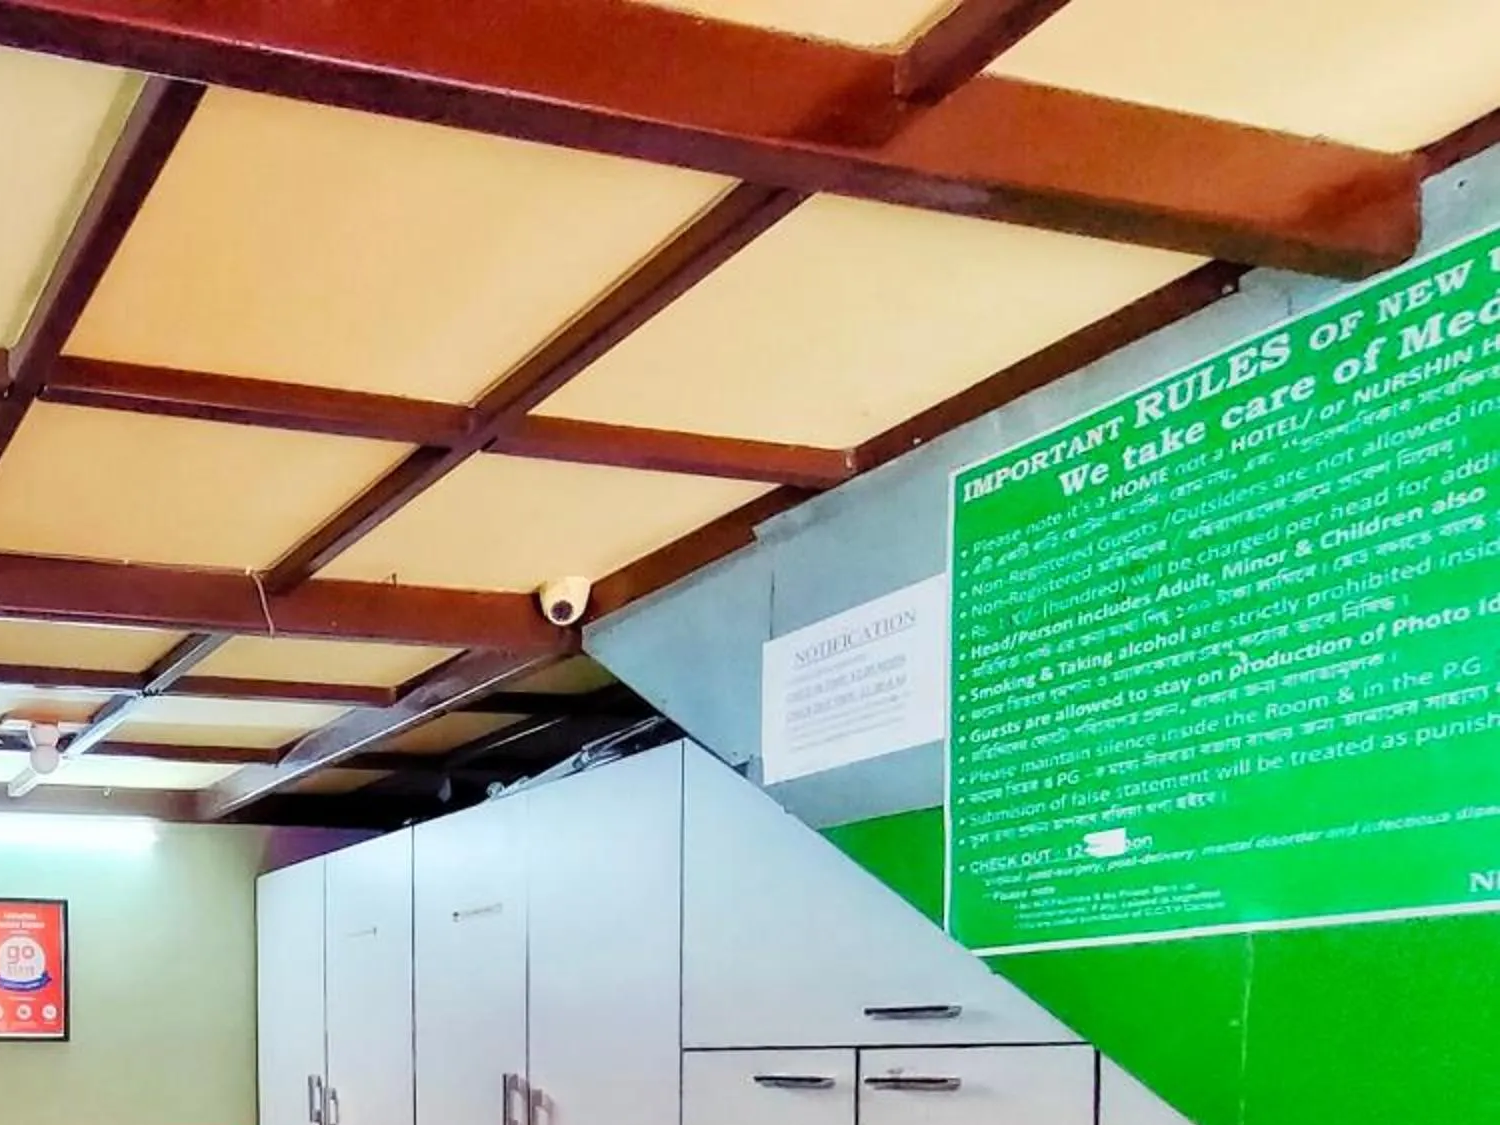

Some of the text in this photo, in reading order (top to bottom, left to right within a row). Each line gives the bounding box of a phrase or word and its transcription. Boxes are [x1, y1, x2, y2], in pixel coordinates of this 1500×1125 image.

[964, 413, 1123, 503] IMPORTANT
[1134, 330, 1290, 429] RULES
[1308, 307, 1363, 354] OF
[1377, 257, 1474, 325] NEW
[1058, 451, 1108, 500] We
[1122, 410, 1206, 473] take
[1220, 372, 1316, 433] care
[1332, 333, 1387, 388] of
[1110, 464, 1169, 503] HOME
[1320, 397, 1345, 421] or
[1352, 343, 1472, 409] NURSHIN
[1096, 517, 1156, 553] Guests
[1273, 464, 1308, 489] are
[1316, 444, 1354, 474] not
[1362, 403, 1462, 458] allowed
[1196, 523, 1278, 569] charged
[1285, 510, 1323, 539] per
[1330, 485, 1388, 521] head
[1396, 471, 1431, 500] for
[794, 608, 916, 664] NOTIFICATION
[970, 613, 1073, 663] Head/Person
[1077, 589, 1149, 627] includes
[1156, 567, 1215, 603] Adult,
[1221, 543, 1288, 582] Minor
[1294, 536, 1312, 559] &
[1320, 499, 1424, 551] Children
[1431, 480, 1486, 517] also
[970, 669, 1035, 705] Smoking
[1040, 665, 1053, 682] &
[1058, 647, 1112, 680] Taking
[1118, 625, 1185, 660] alcohol
[1191, 618, 1221, 640] are
[1229, 593, 1298, 632] strictly
[1306, 553, 1430, 610] prohibited
[969, 717, 1020, 744] Guests
[1025, 712, 1050, 730] are
[1055, 691, 1123, 723] allowed
[1128, 686, 1146, 704] to
[1153, 674, 1190, 701] stay
[1197, 668, 1222, 687] on
[1229, 630, 1352, 681] production
[1360, 621, 1385, 646] of
[1392, 599, 1470, 638] Photo
[1021, 746, 1090, 774] maintain
[1224, 706, 1256, 729] the
[1264, 689, 1328, 720] Room
[1337, 683, 1354, 705] &
[1363, 677, 1383, 698] in
[1392, 665, 1433, 692] the
[1071, 785, 1110, 807] false
[1117, 766, 1208, 799] statement
[1218, 757, 1250, 780] will
[1257, 750, 1284, 773] be
[1290, 733, 1374, 767] treated
[1380, 731, 1407, 750] as
[969, 854, 1016, 874] CHECK
[1020, 848, 1051, 866] OUT
